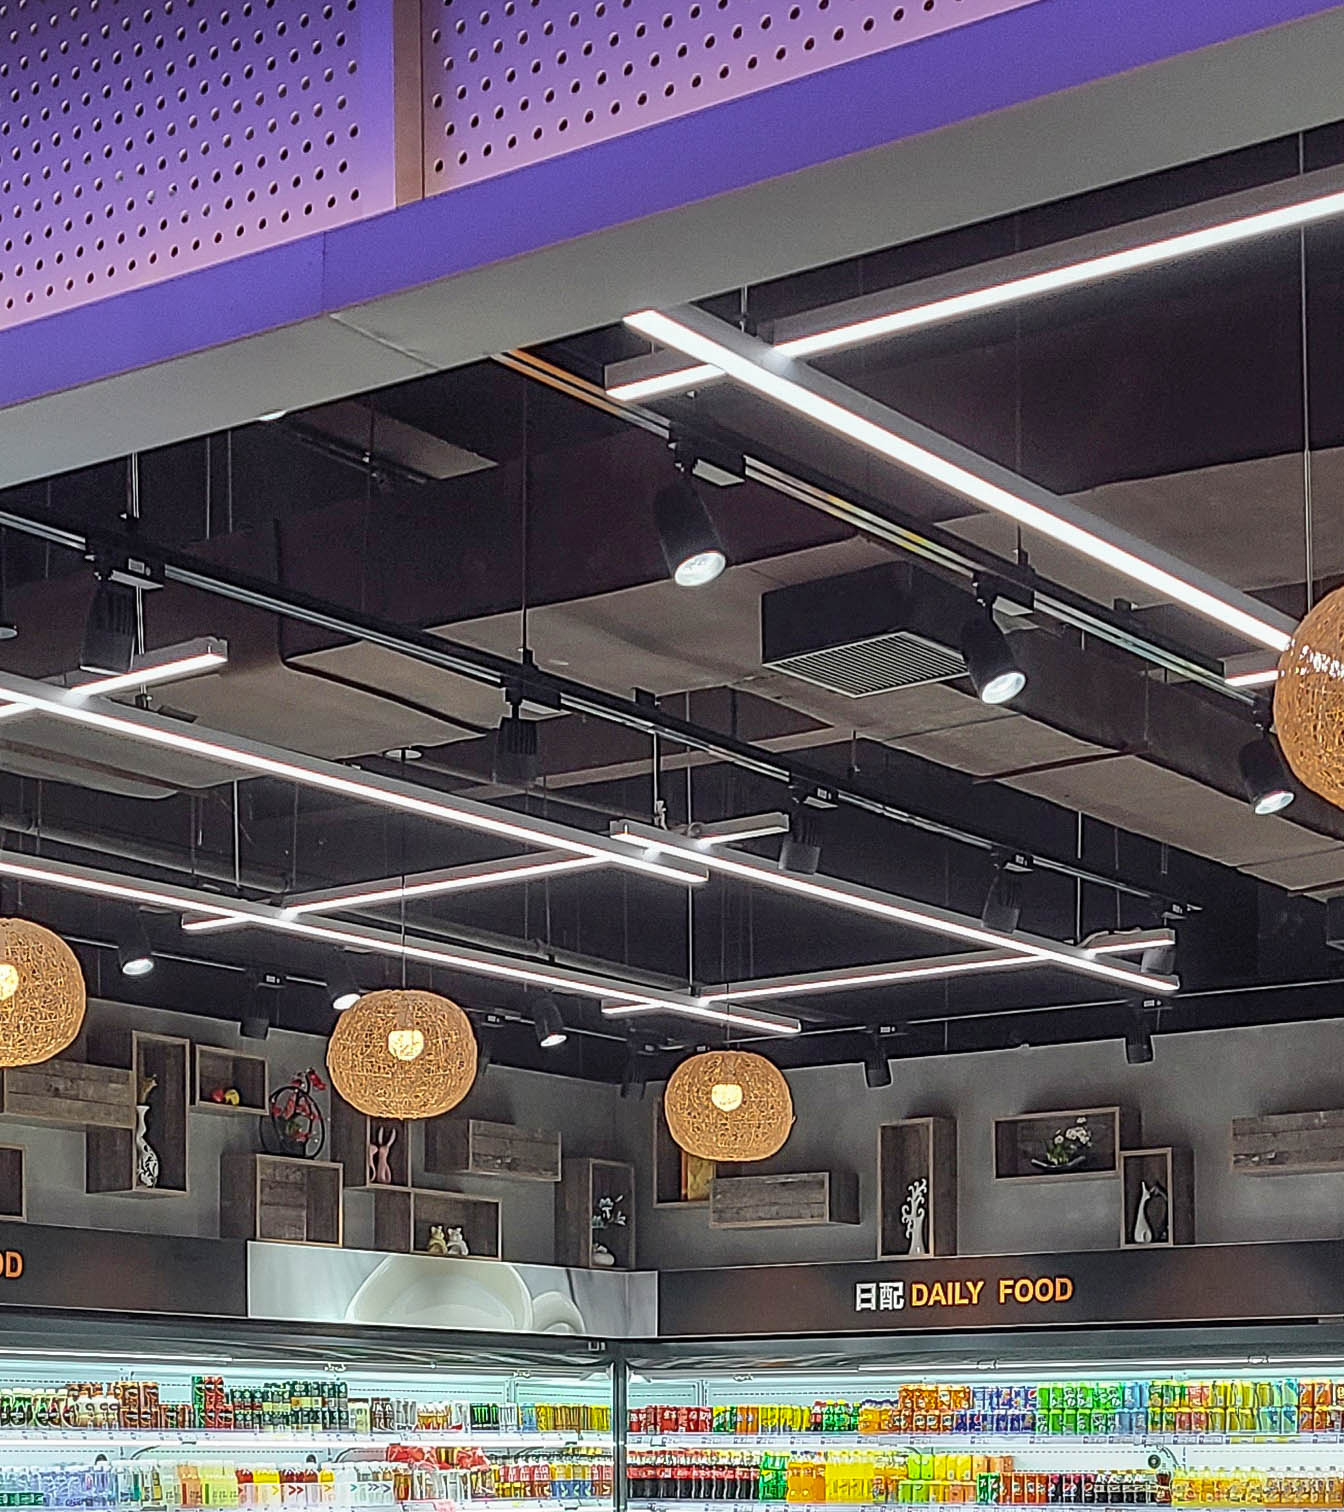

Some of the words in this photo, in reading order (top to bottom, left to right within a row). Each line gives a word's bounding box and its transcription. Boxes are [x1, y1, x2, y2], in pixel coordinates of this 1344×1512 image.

[855, 1281, 904, 1311] 日配
[911, 1280, 984, 1307] DAILY
[999, 1277, 1073, 1304] FOOD
